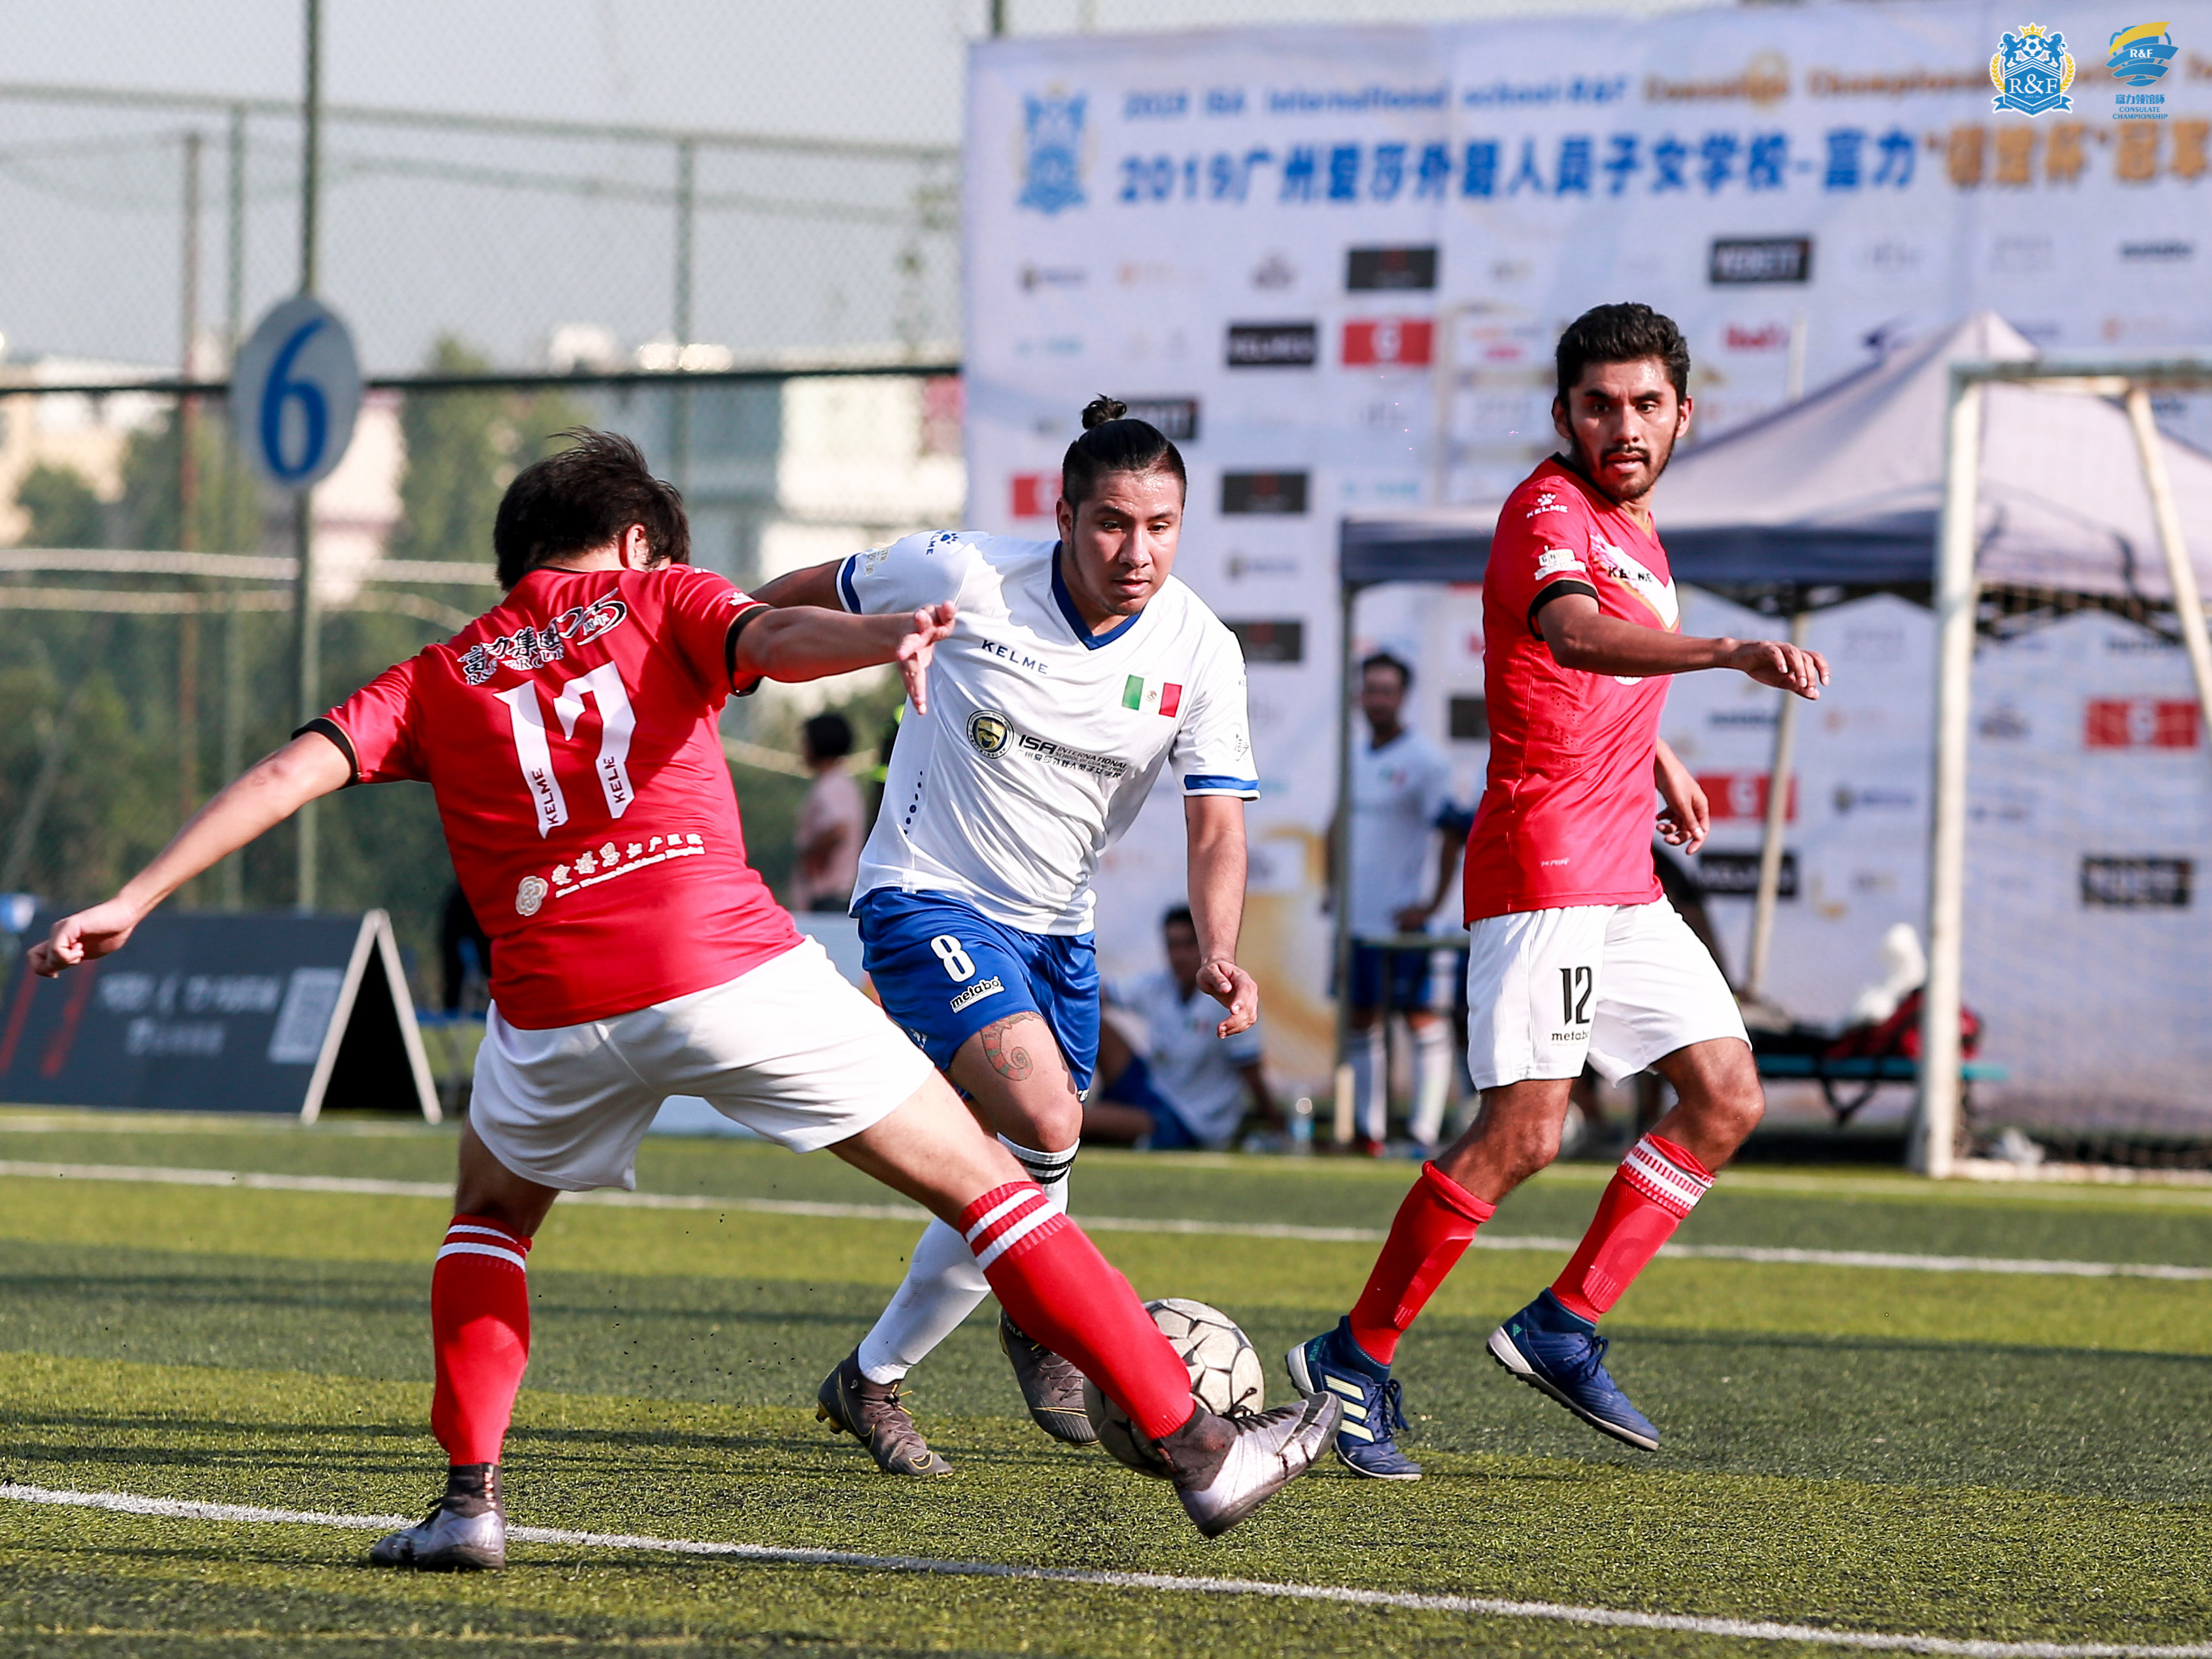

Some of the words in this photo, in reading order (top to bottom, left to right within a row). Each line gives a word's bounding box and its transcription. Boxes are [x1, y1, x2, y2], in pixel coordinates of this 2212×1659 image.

[260, 317, 328, 483] 6
[1527, 504, 1568, 519] KELME
[981, 639, 1049, 675] KELME
[492, 660, 637, 840] 17
[1019, 734, 1058, 754] ISA
[1055, 752, 1079, 762] SCHOOL
[1057, 746, 1127, 769] INTERNATIONAL
[532, 767, 560, 825] KELME
[930, 935, 976, 982] 8
[951, 977, 1002, 1008] metabo
[1559, 966, 1593, 1027] 12
